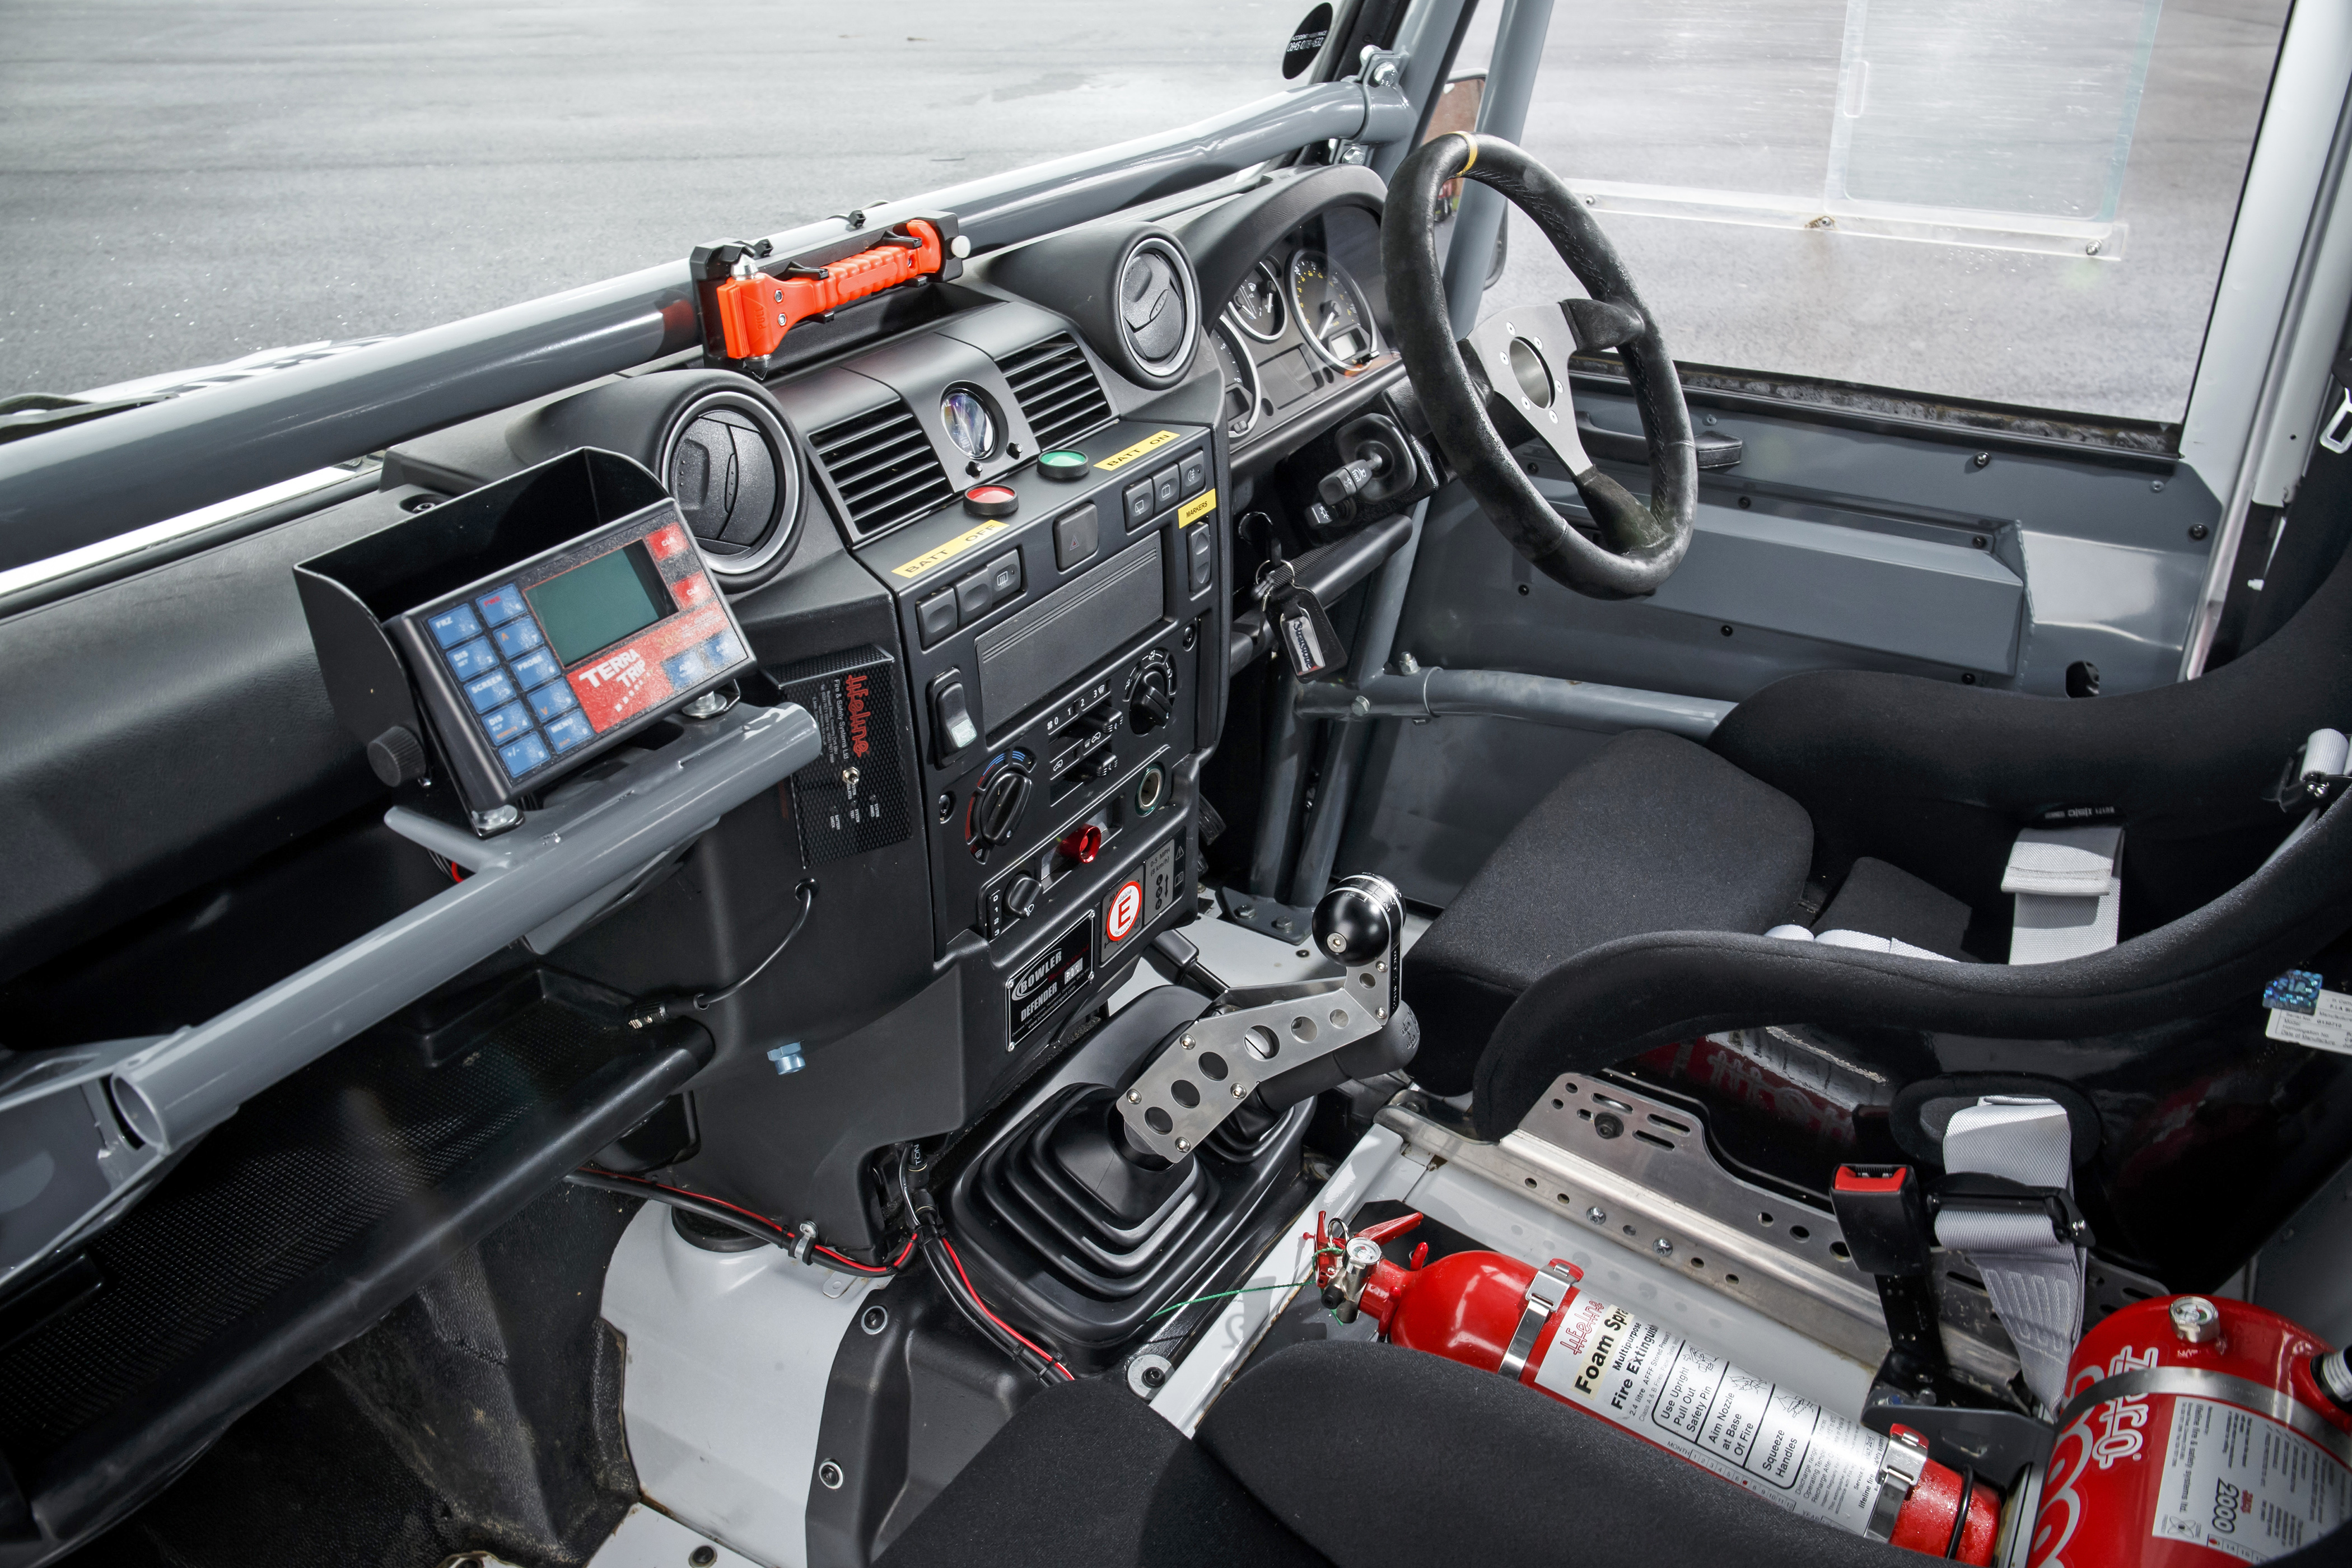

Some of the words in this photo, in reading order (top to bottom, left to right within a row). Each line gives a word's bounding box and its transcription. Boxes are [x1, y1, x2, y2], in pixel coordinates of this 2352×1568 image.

[1107, 447, 1141, 467] BATT
[1149, 434, 1172, 447] ON
[1186, 500, 1208, 519] MARKERS
[904, 549, 950, 573] BATT
[965, 524, 996, 543] OFF
[436, 617, 453, 628] FRZ
[453, 650, 469, 661] DIS
[517, 654, 543, 671] PROBE
[578, 648, 641, 688] TERRA
[471, 675, 503, 694] SCREEN
[617, 659, 646, 688] TRIP
[836, 699, 844, 720] Safety
[1080, 698, 1085, 707] 2
[1093, 689, 1098, 698] 3
[488, 715, 503, 726] DIS
[551, 718, 573, 733] MENU
[838, 721, 848, 748] Systems
[1150, 857, 1158, 867] 0-5
[1159, 847, 1170, 860] MPH
[994, 917, 1000, 925] 2
[1118, 895, 1131, 930] E
[1019, 950, 1062, 995] BOWLER
[1021, 982, 1058, 1022] DEFENDER
[1573, 1333, 1615, 1394] Foam
[1603, 1304, 1631, 1333] Spra
[1612, 1320, 1642, 1371] Multipurpose
[1611, 1376, 1634, 1410] Fire
[1626, 1322, 1660, 1375] Extinguish
[1628, 1403, 1639, 1416] 2.4
[1634, 1387, 1646, 1403] litre
[1641, 1366, 1655, 1385] AFFF
[1650, 1347, 1664, 1366] Stored
[1660, 1398, 1676, 1420] Use
[1669, 1366, 1691, 1399] Upright
[1637, 1403, 1650, 1422] Class
[1673, 1404, 1688, 1426] Pull
[1682, 1386, 1697, 1405] Out
[1686, 1401, 1707, 1433] Safety
[1699, 1384, 1713, 1401] Pin
[1706, 1420, 1724, 1444] Aim
[1715, 1390, 1737, 1421] Nozzle
[1725, 1412, 1743, 1438] Base
[1739, 1421, 1755, 1443] Fire
[1666, 1440, 1691, 1457] MONTH
[1719, 1437, 1732, 1450] at
[1733, 1441, 1747, 1457] Of
[1762, 1429, 1786, 1472] Squeeze
[1865, 1435, 1874, 1447] 2015
[1775, 1438, 1799, 1478] Handles
[1794, 1463, 1813, 1495] Discharge
[1808, 1446, 1819, 1463] range
[1802, 1464, 1822, 1499] Operating
[1810, 1472, 1828, 1503] Recharge
[1822, 1458, 1833, 1473] After
[1852, 1470, 1865, 1490] Service
[1858, 1485, 1872, 1509] lifeline
[1866, 1473, 1875, 1485] fire
[1827, 1500, 1836, 1511] This
[2212, 1477, 2239, 1533] 2000
